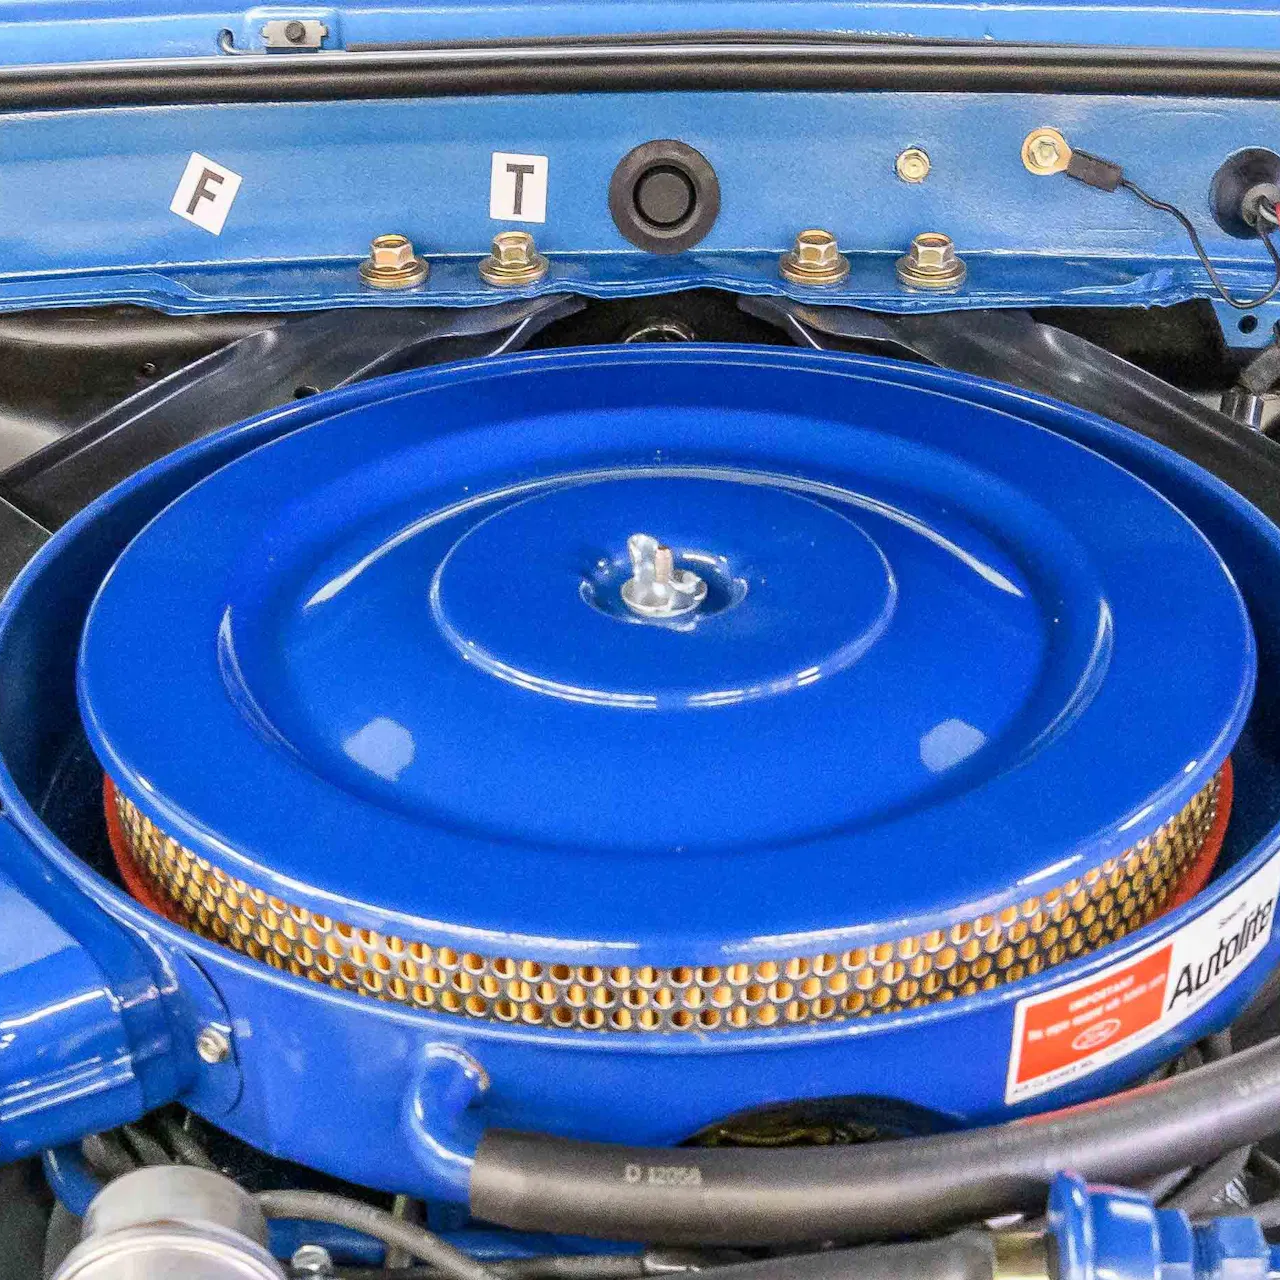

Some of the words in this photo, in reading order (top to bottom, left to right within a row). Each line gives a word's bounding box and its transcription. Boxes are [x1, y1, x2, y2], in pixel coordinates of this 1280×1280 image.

[186, 167, 224, 216] F
[506, 163, 535, 215] T
[1169, 897, 1276, 1011] Autolite
